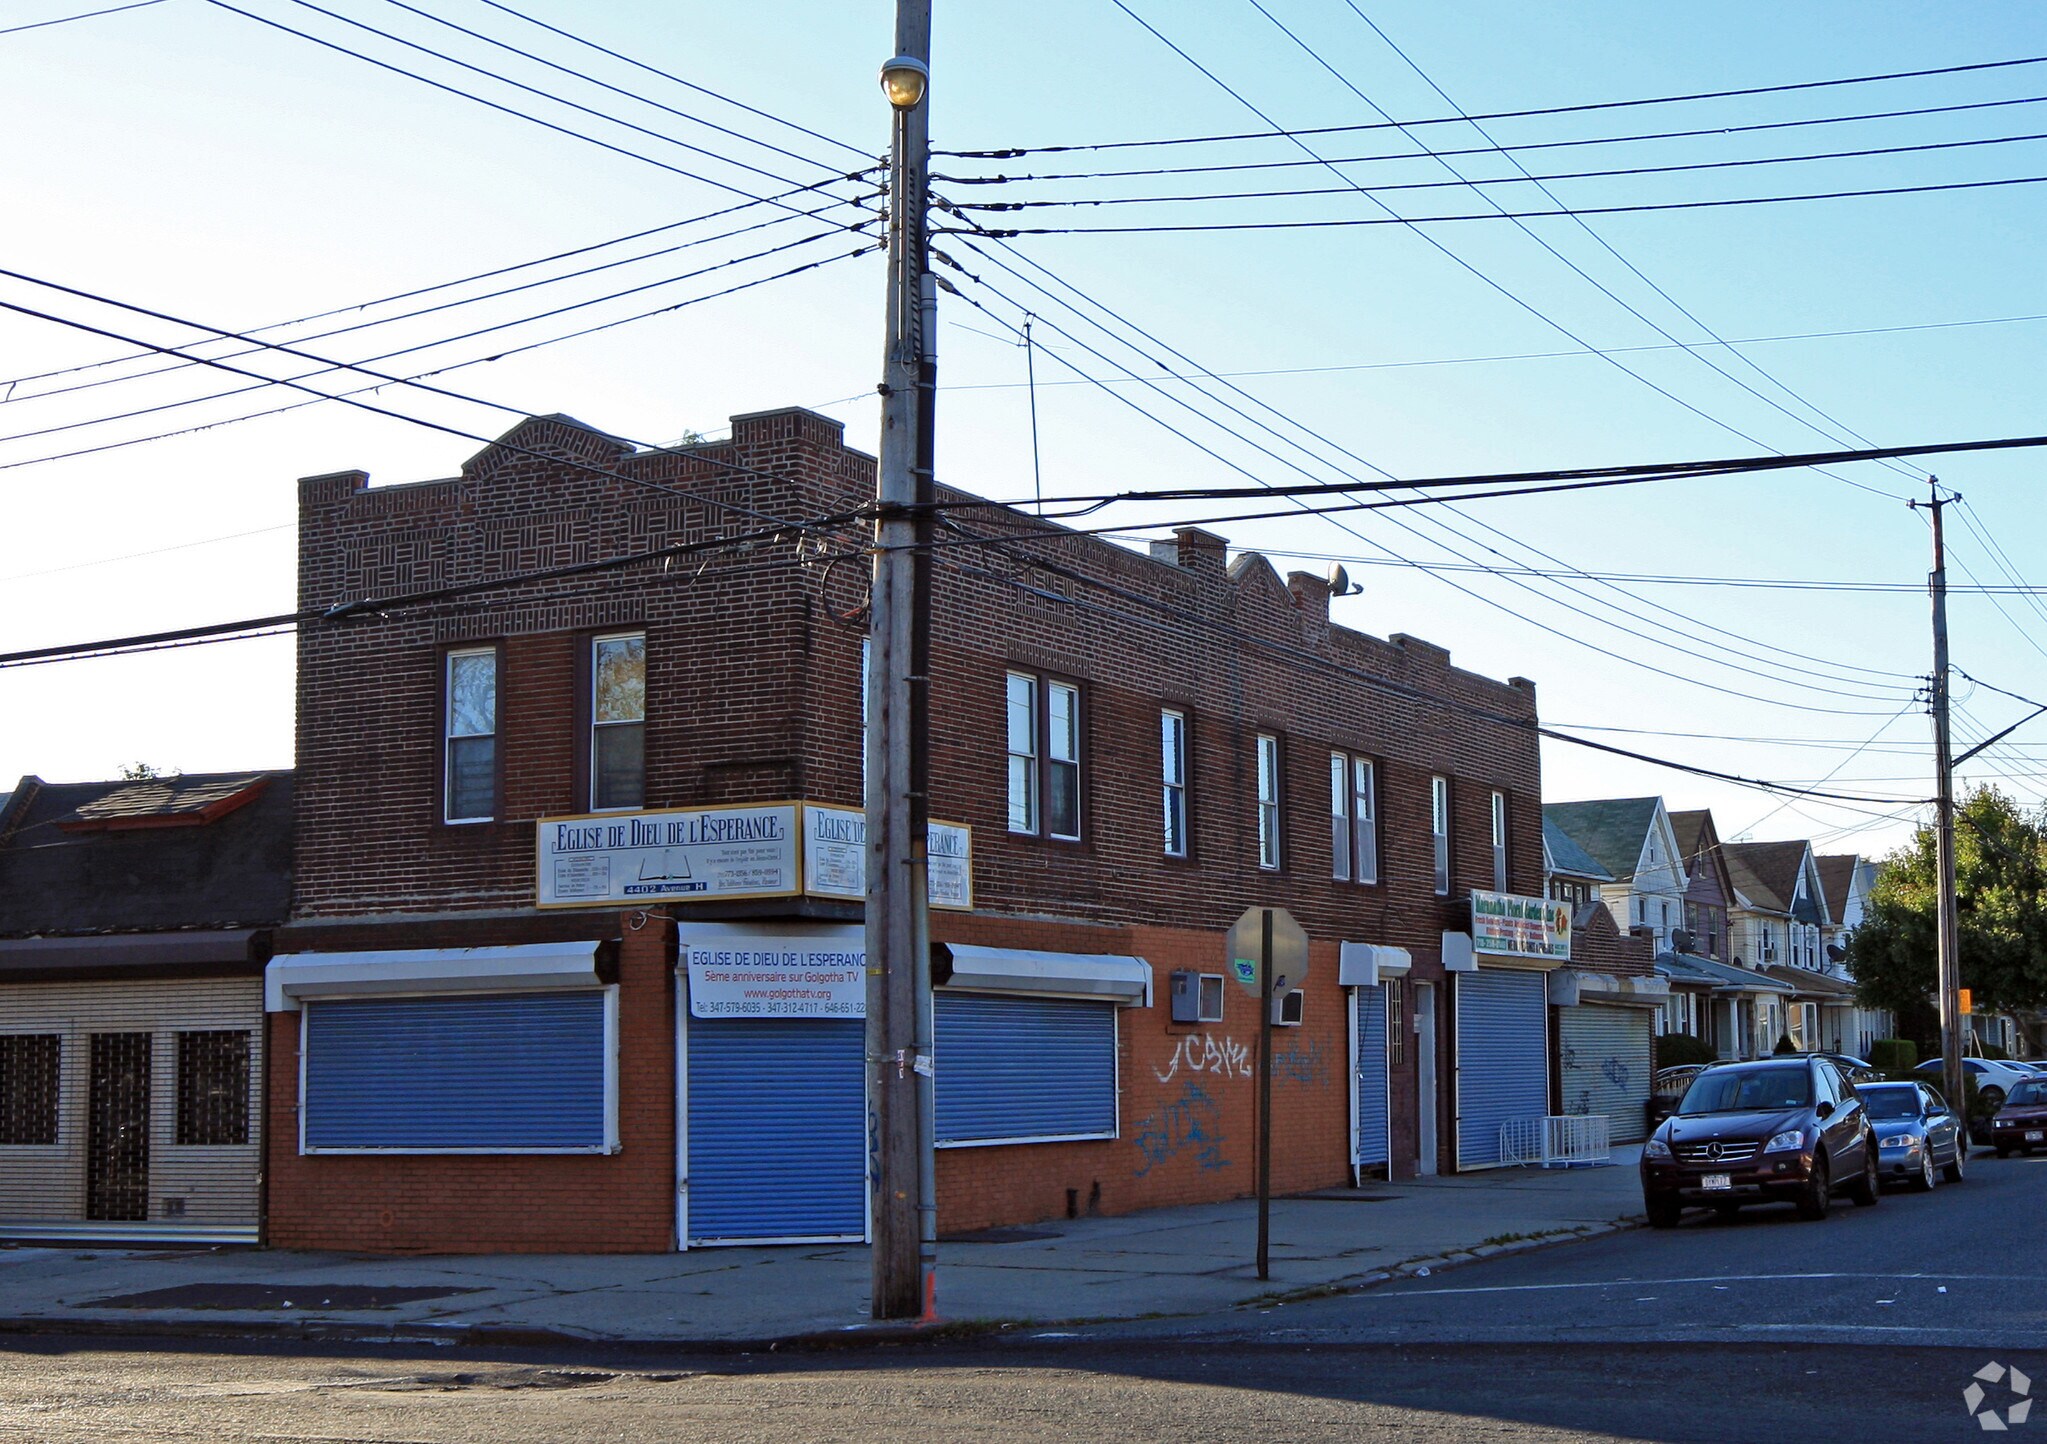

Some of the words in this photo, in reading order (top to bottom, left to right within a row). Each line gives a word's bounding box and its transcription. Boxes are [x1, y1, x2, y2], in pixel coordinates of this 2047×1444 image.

[607, 825, 625, 847] DE
[630, 819, 661, 846] DIEU
[667, 821, 684, 844] DE
[929, 831, 959, 855] ERANCE
[626, 885, 656, 893] 4402
[660, 884, 690, 892] Avenue
[692, 951, 731, 965] EGLISE
[735, 952, 750, 966] DE
[753, 952, 779, 966] DIEU
[782, 953, 797, 966] DE
[801, 953, 866, 966] L'ESPERANC
[705, 970, 729, 982] 5ème
[732, 971, 787, 982] anniversaire
[789, 973, 803, 982] sur
[804, 972, 844, 984] Golgotha
[847, 971, 859, 982] TV
[744, 988, 832, 1001] www.golgothatv.org
[824, 1002, 865, 1013] 646-651-22
